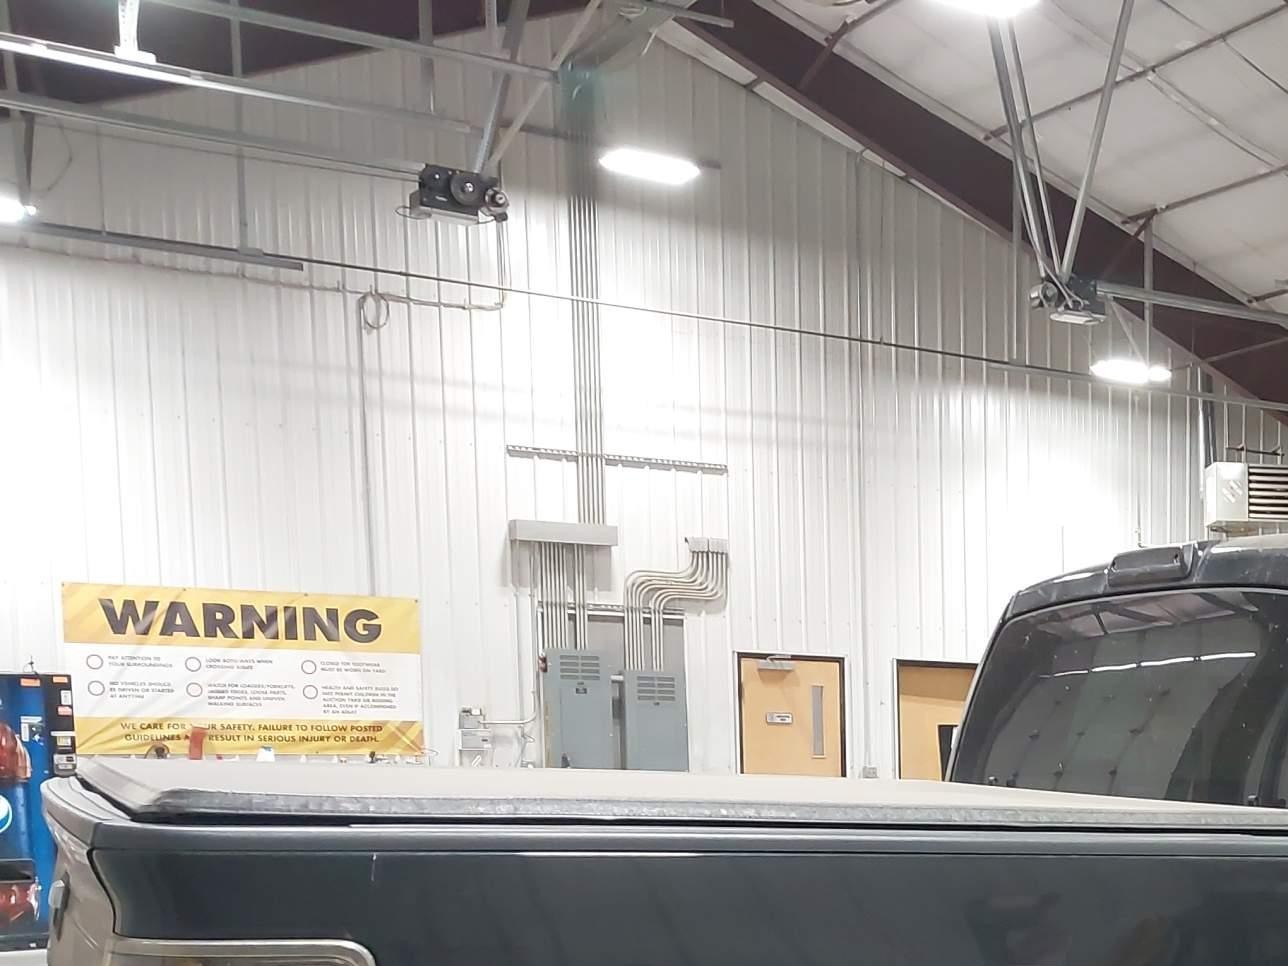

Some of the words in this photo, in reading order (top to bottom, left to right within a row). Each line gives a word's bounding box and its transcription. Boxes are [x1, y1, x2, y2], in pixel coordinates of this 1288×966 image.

[98, 598, 382, 643] WARNING
[220, 723, 255, 731] SAFETY.
[258, 724, 292, 732] FAILURE
[295, 724, 308, 732] TO
[311, 724, 348, 732] FOLLOW
[124, 733, 181, 741] GUIDELINES
[209, 734, 241, 742] RESULT
[243, 734, 255, 742] IN
[258, 735, 296, 743] SERIOUS
[299, 735, 330, 743] INJURY
[333, 735, 347, 743] OR
[350, 735, 380, 743] DEATH.
